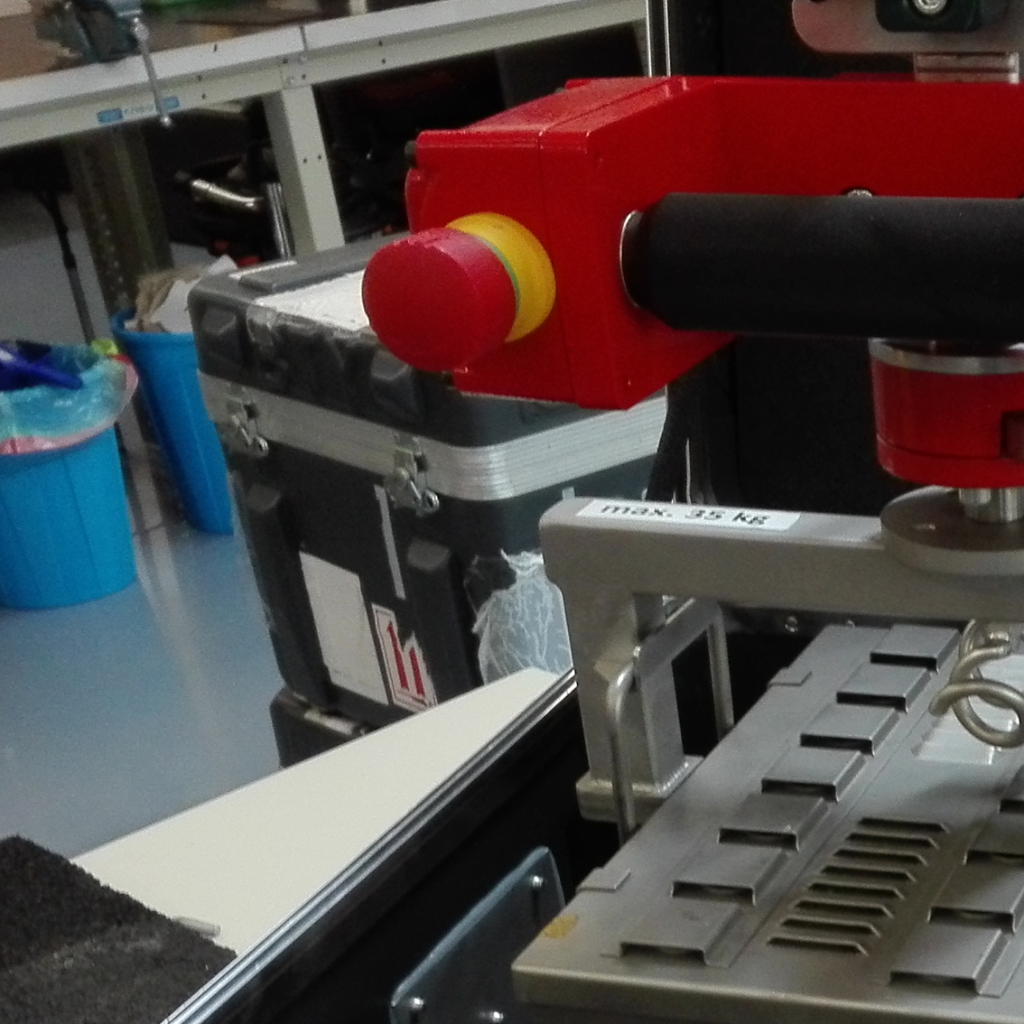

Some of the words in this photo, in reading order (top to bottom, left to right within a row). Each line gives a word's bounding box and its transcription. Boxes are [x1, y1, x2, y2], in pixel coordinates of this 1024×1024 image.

[600, 504, 673, 518] max.
[684, 507, 726, 520] 35
[732, 511, 770, 526] kg
